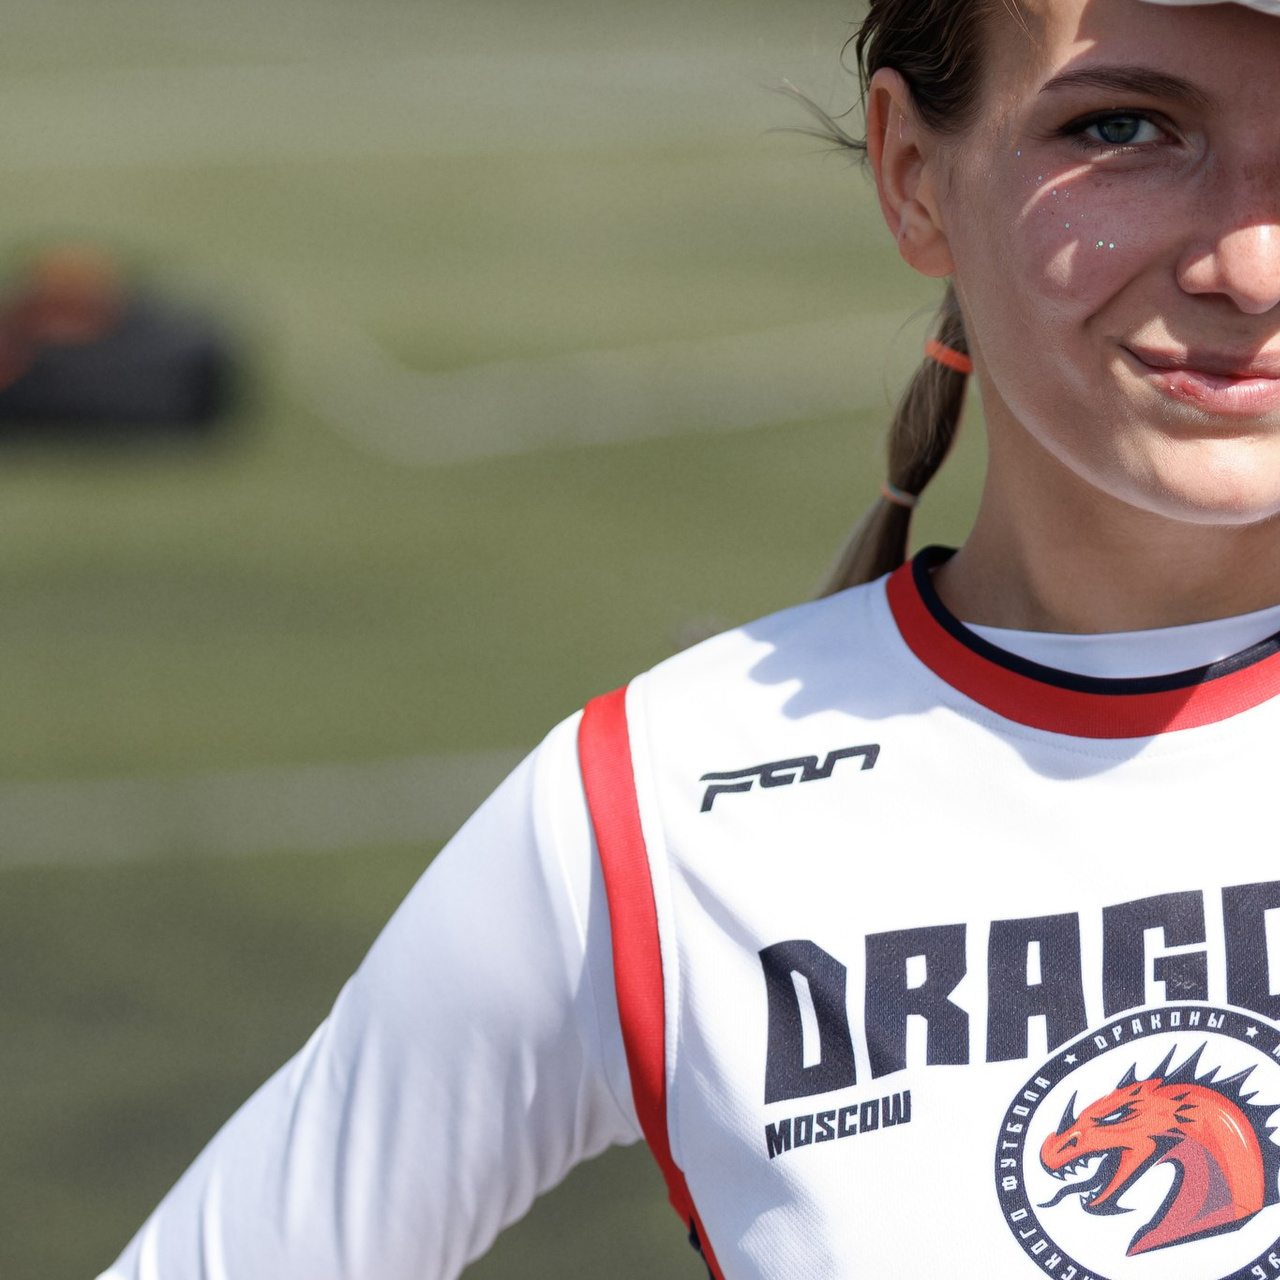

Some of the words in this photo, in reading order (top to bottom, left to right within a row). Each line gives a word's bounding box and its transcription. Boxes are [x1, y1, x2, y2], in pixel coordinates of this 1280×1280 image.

[1094, 1010, 1225, 1049] ДРАКОНЫ
[765, 1089, 911, 1159] MOSCOW
[1001, 1076, 1050, 1191] ФУТБОЛА
